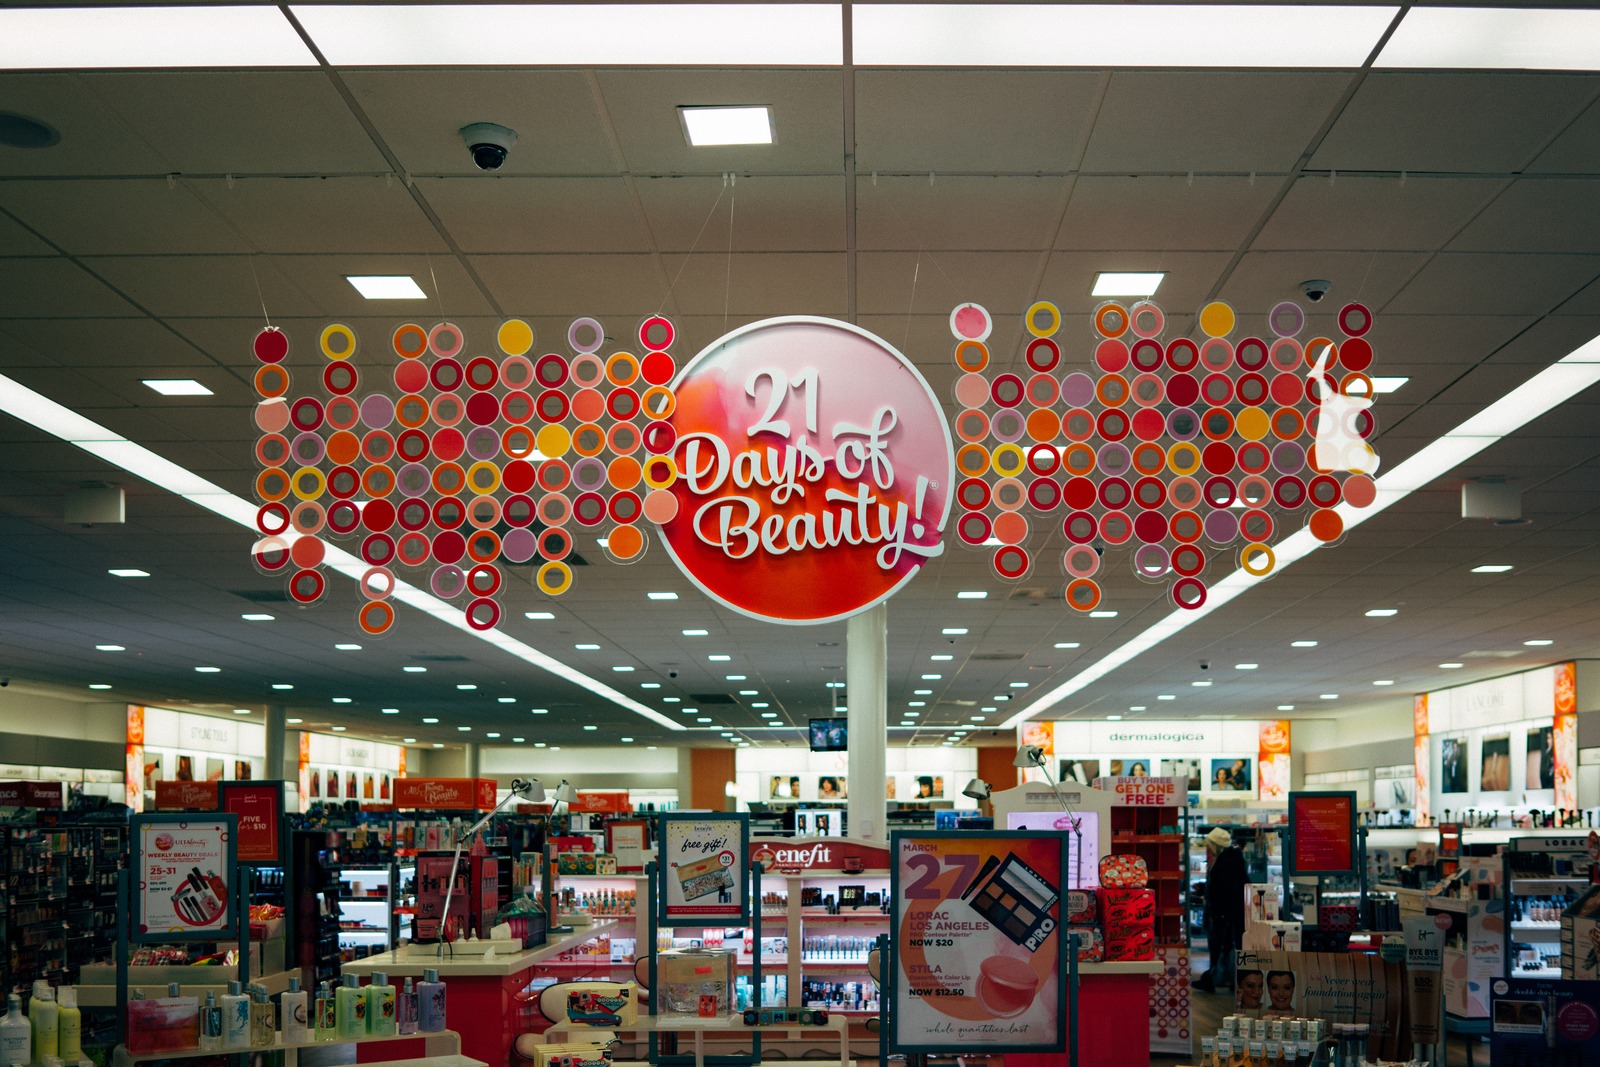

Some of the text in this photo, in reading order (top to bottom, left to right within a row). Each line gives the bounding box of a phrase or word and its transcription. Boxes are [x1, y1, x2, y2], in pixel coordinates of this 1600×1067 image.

[745, 366, 819, 438] 21
[667, 406, 897, 505] Days of
[693, 475, 944, 570] Beauty!
[191, 726, 228, 742] STYLING TOOLS
[1109, 732, 1204, 742] dermalogica
[1115, 784, 1174, 794] GET ONE
[1125, 794, 1165, 804] FREE
[681, 839, 727, 853] free gift!
[905, 854, 979, 900] 27
[910, 912, 949, 920] LORAC
[910, 922, 989, 930] LOS ANGELES
[936, 939, 953, 947] $20
[1237, 951, 1256, 966] it
[910, 965, 942, 973] STILA
[1322, 975, 1350, 985] Never
[935, 988, 964, 996] $12.50
[1302, 987, 1355, 998] foundation
[1552, 990, 1574, 999] beauty
[924, 1022, 1031, 1037] while quantities last
